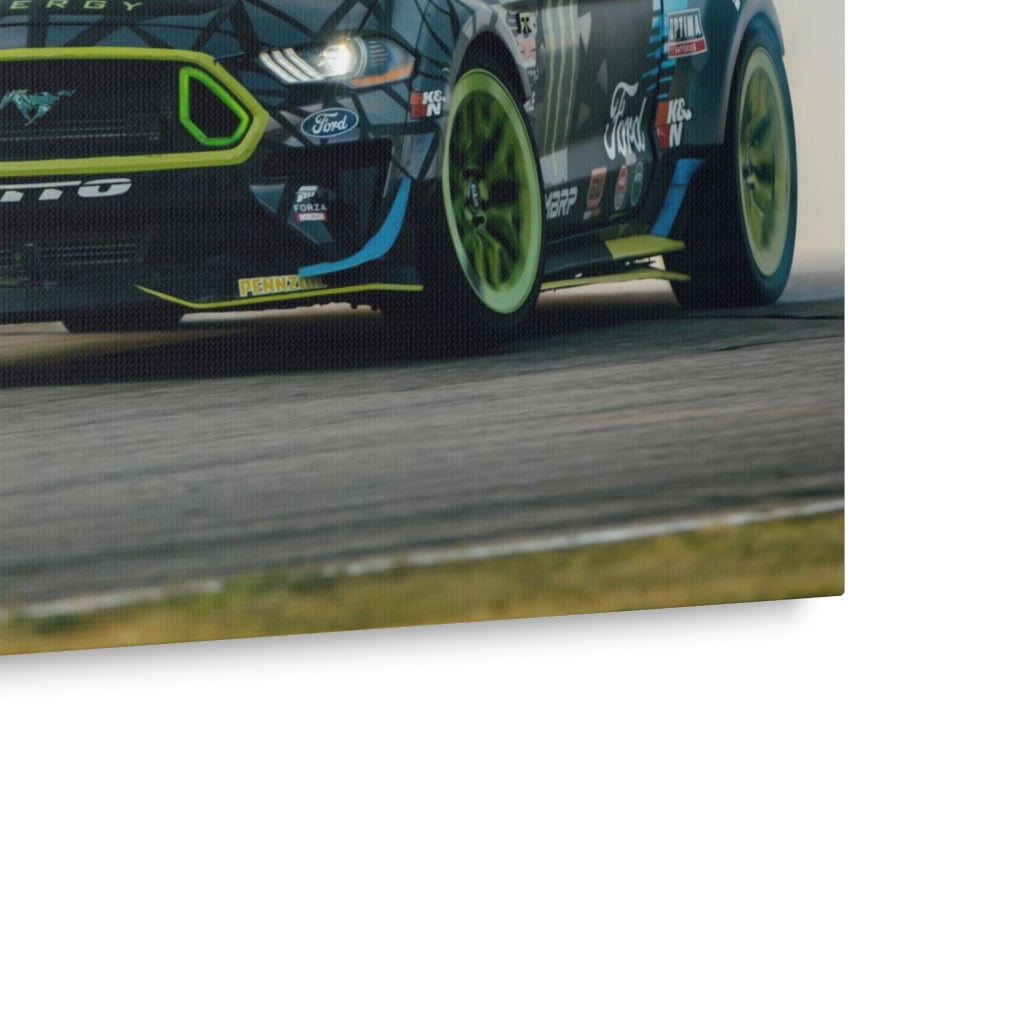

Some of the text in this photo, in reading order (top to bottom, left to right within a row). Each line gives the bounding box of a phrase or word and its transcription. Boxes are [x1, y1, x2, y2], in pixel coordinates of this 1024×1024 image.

[669, 13, 703, 41] OPTIMA
[312, 112, 349, 135] Ford
[604, 81, 648, 161] Ford
[293, 203, 328, 213] FORZA
